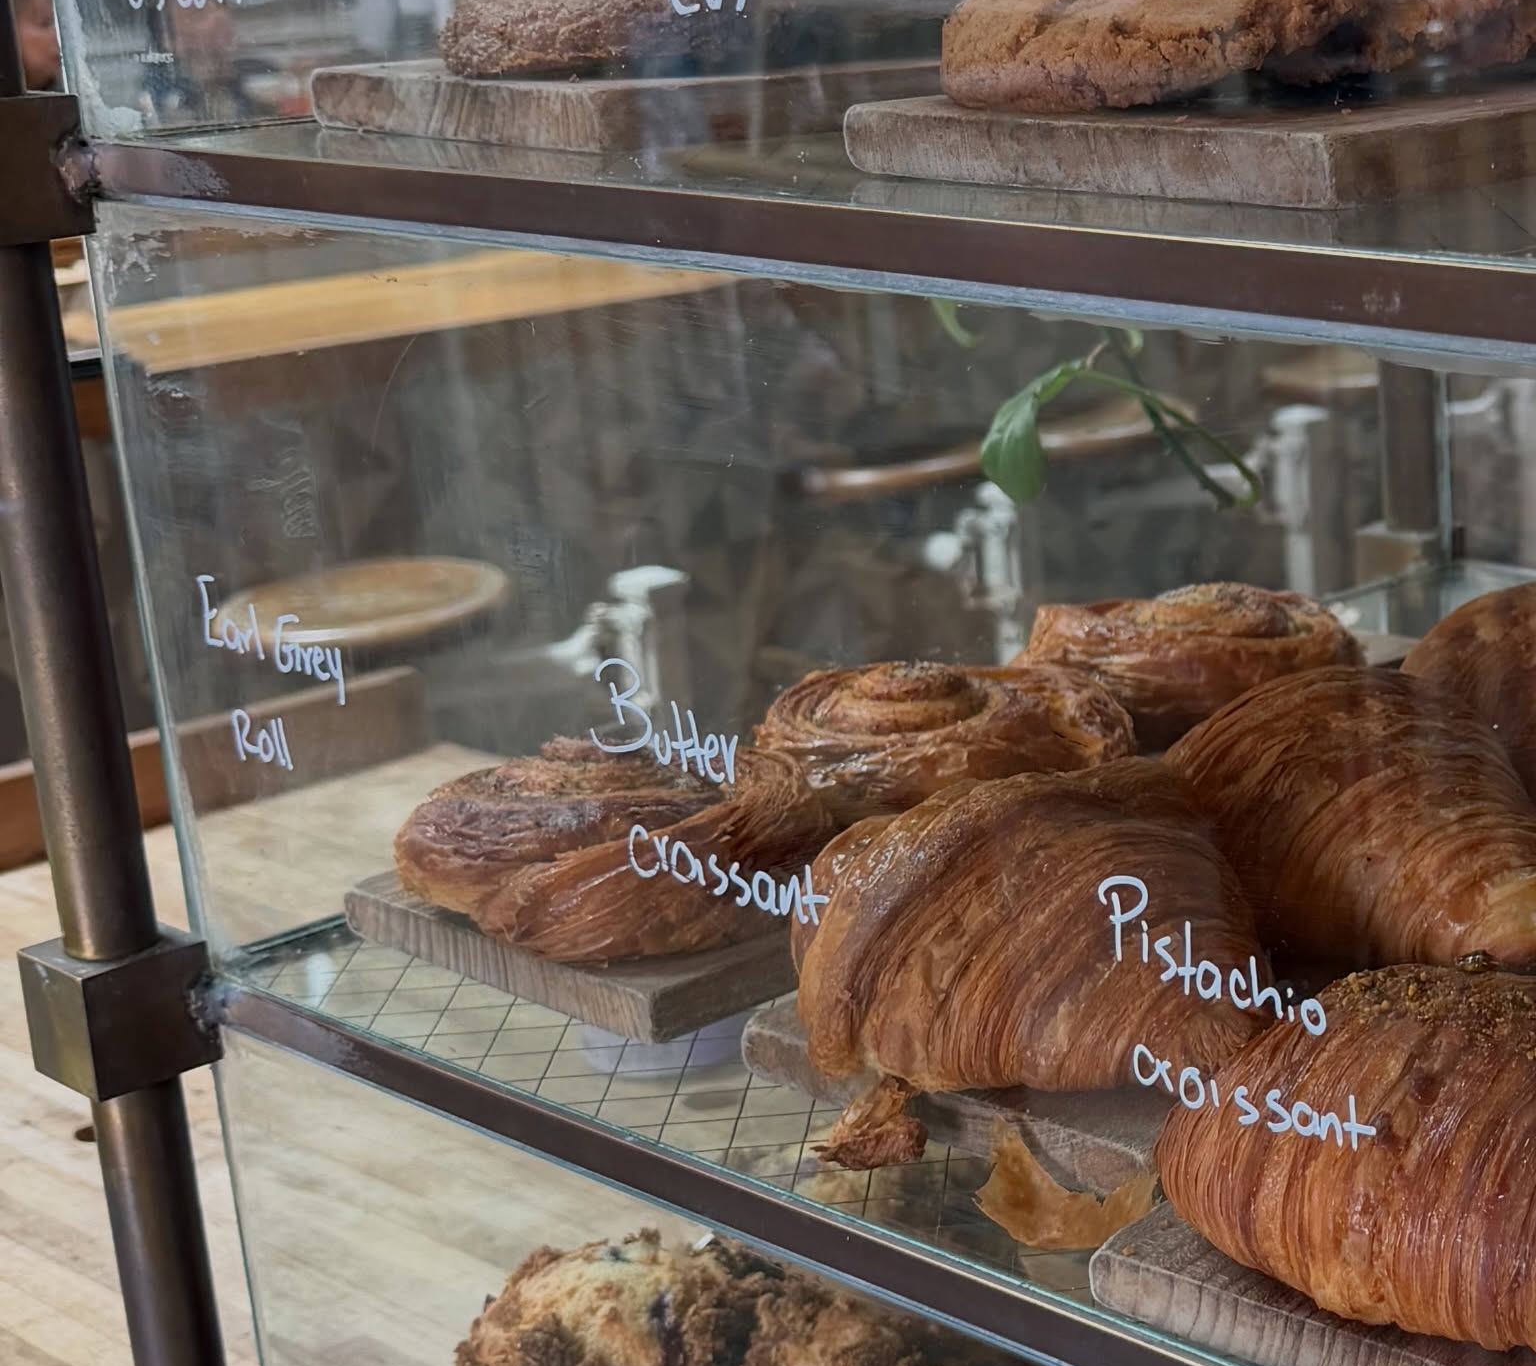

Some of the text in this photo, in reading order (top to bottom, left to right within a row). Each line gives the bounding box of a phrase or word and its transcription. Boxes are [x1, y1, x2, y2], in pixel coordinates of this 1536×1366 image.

[196, 575, 346, 706] Earl Grey
[231, 709, 293, 770] Roll
[590, 657, 739, 784] Butter
[1098, 875, 1327, 1035] Pistachio
